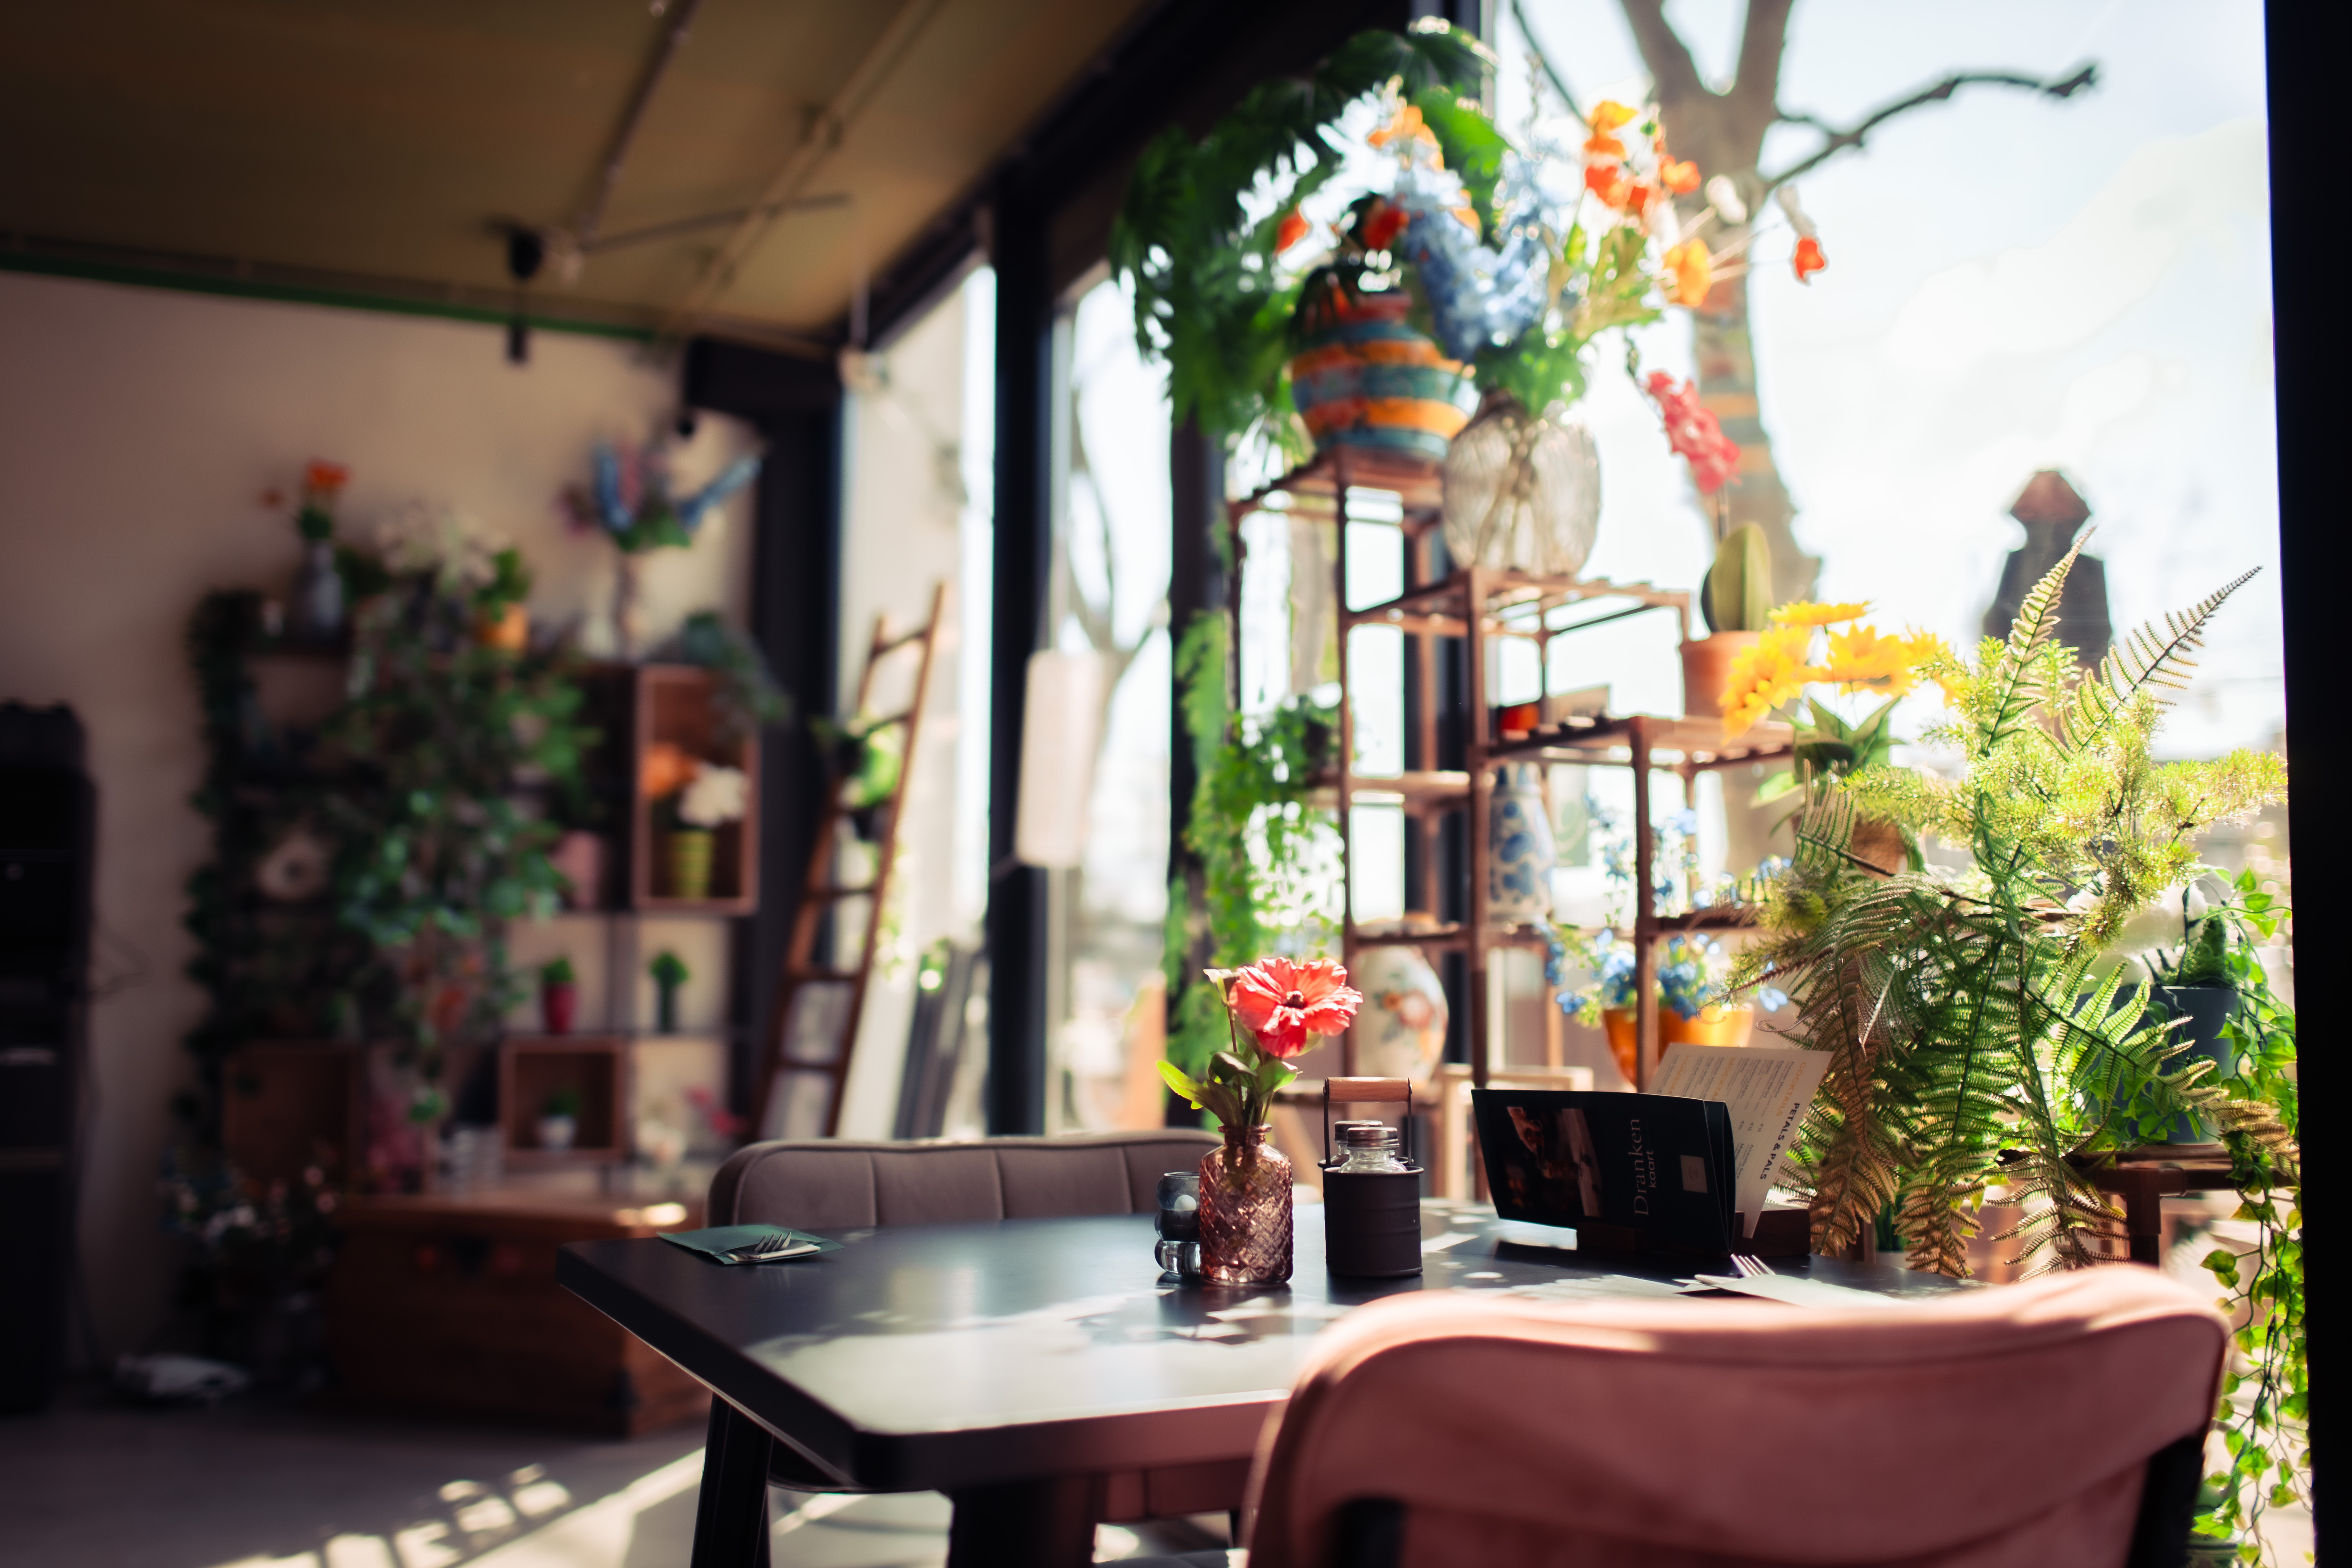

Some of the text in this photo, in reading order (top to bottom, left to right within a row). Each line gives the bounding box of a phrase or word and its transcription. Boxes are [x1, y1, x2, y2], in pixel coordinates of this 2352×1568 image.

[1668, 1055, 1690, 1094] HOMEMA
[1746, 1059, 1762, 1083] Strawberry
[1764, 1060, 1775, 1074] Mojito
[1771, 1061, 1784, 1081] Espresso
[1782, 1061, 1795, 1080] Pornstar
[1711, 1058, 1736, 1100] MOCKTAI
[1763, 1082, 1774, 1098] Martini
[1773, 1082, 1784, 1098] Martini
[1776, 1062, 1807, 1116] COCKTAILS
[1739, 1085, 1749, 1099] Mojito
[1760, 1103, 1801, 1180] PETALS & PALS
[1741, 1144, 1755, 1166] Amaretto
[1628, 1119, 1649, 1216] Dranken
[1646, 1150, 1657, 1188] kaart
[1736, 1167, 1744, 1179] Sour
